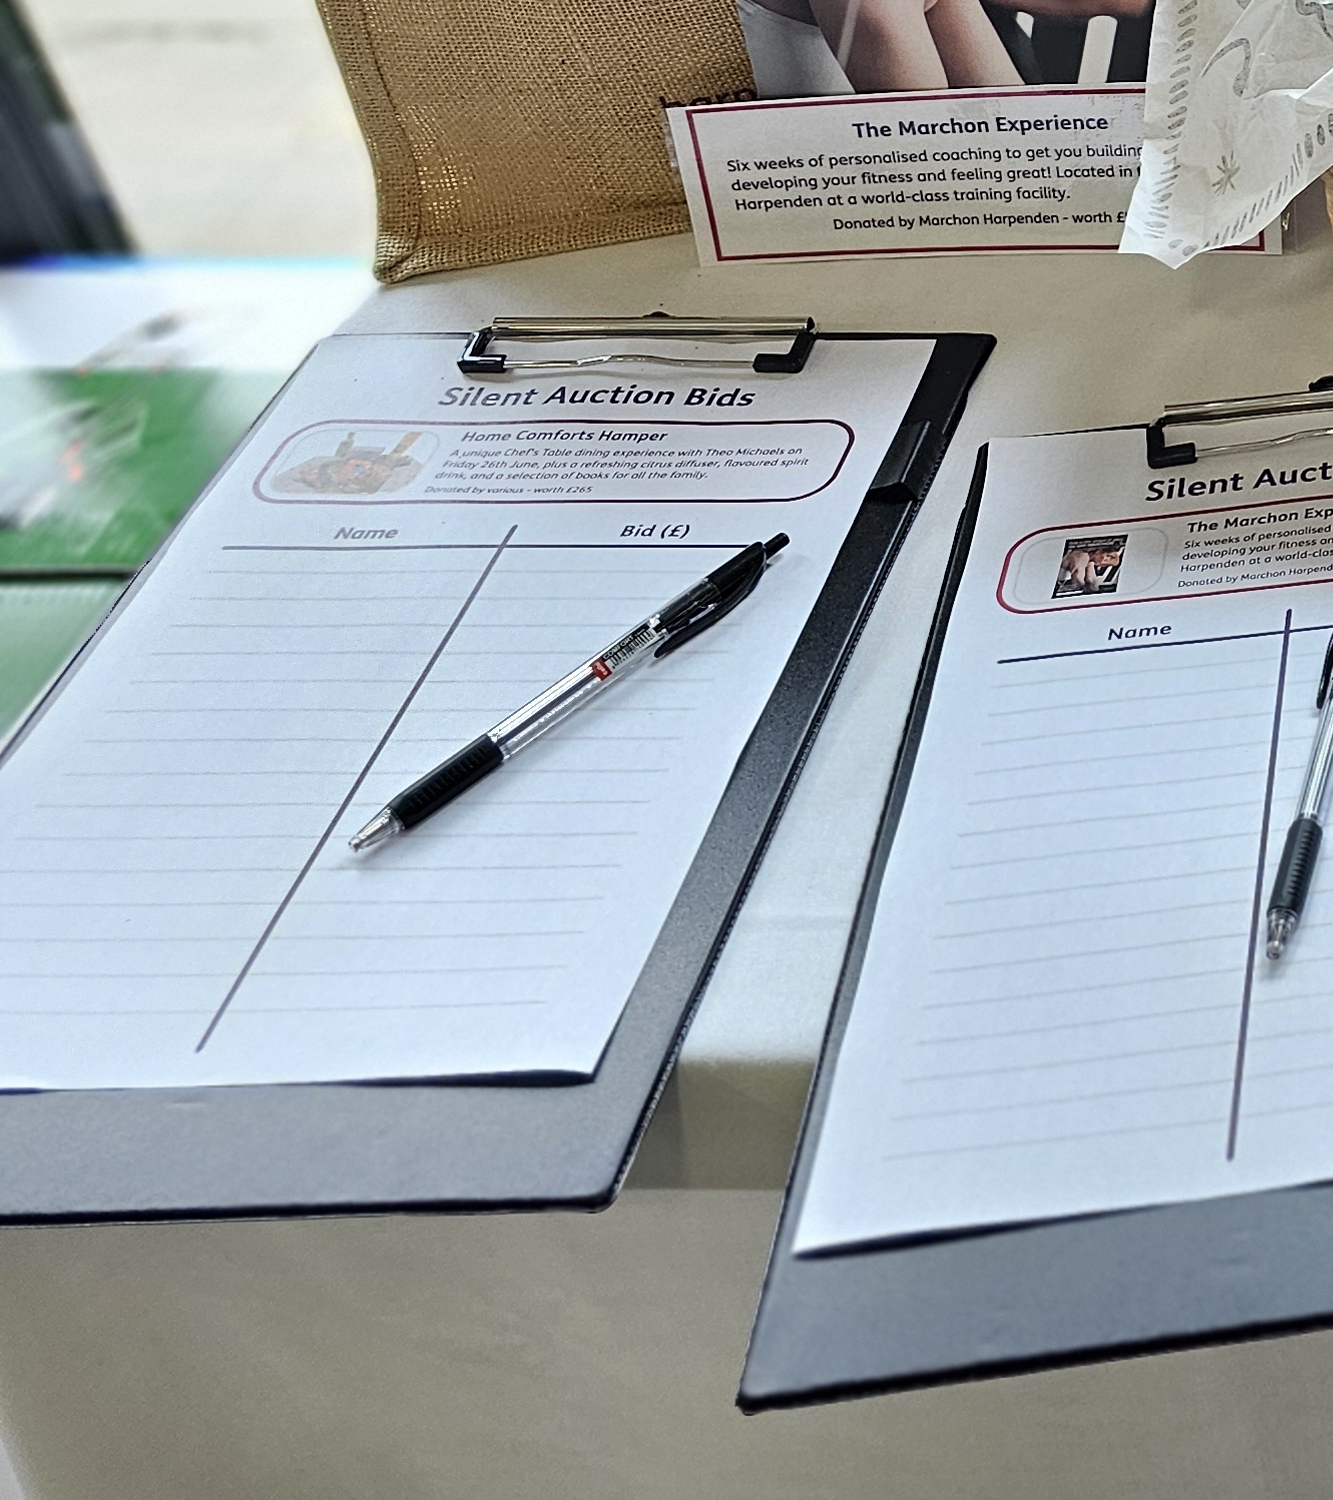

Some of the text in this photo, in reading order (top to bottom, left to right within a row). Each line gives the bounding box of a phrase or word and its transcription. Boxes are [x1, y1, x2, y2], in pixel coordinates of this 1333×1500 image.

[852, 114, 1108, 138] The Marchon Experience
[438, 384, 756, 406] Silent Auction Bids
[461, 430, 668, 444] Home Comforts Hamper
[1145, 473, 1244, 501] Silent
[334, 524, 690, 539] Name Bid (£)
[1187, 521, 1218, 533] The
[1224, 513, 1298, 529] Marchon
[1108, 626, 1171, 640] Name
